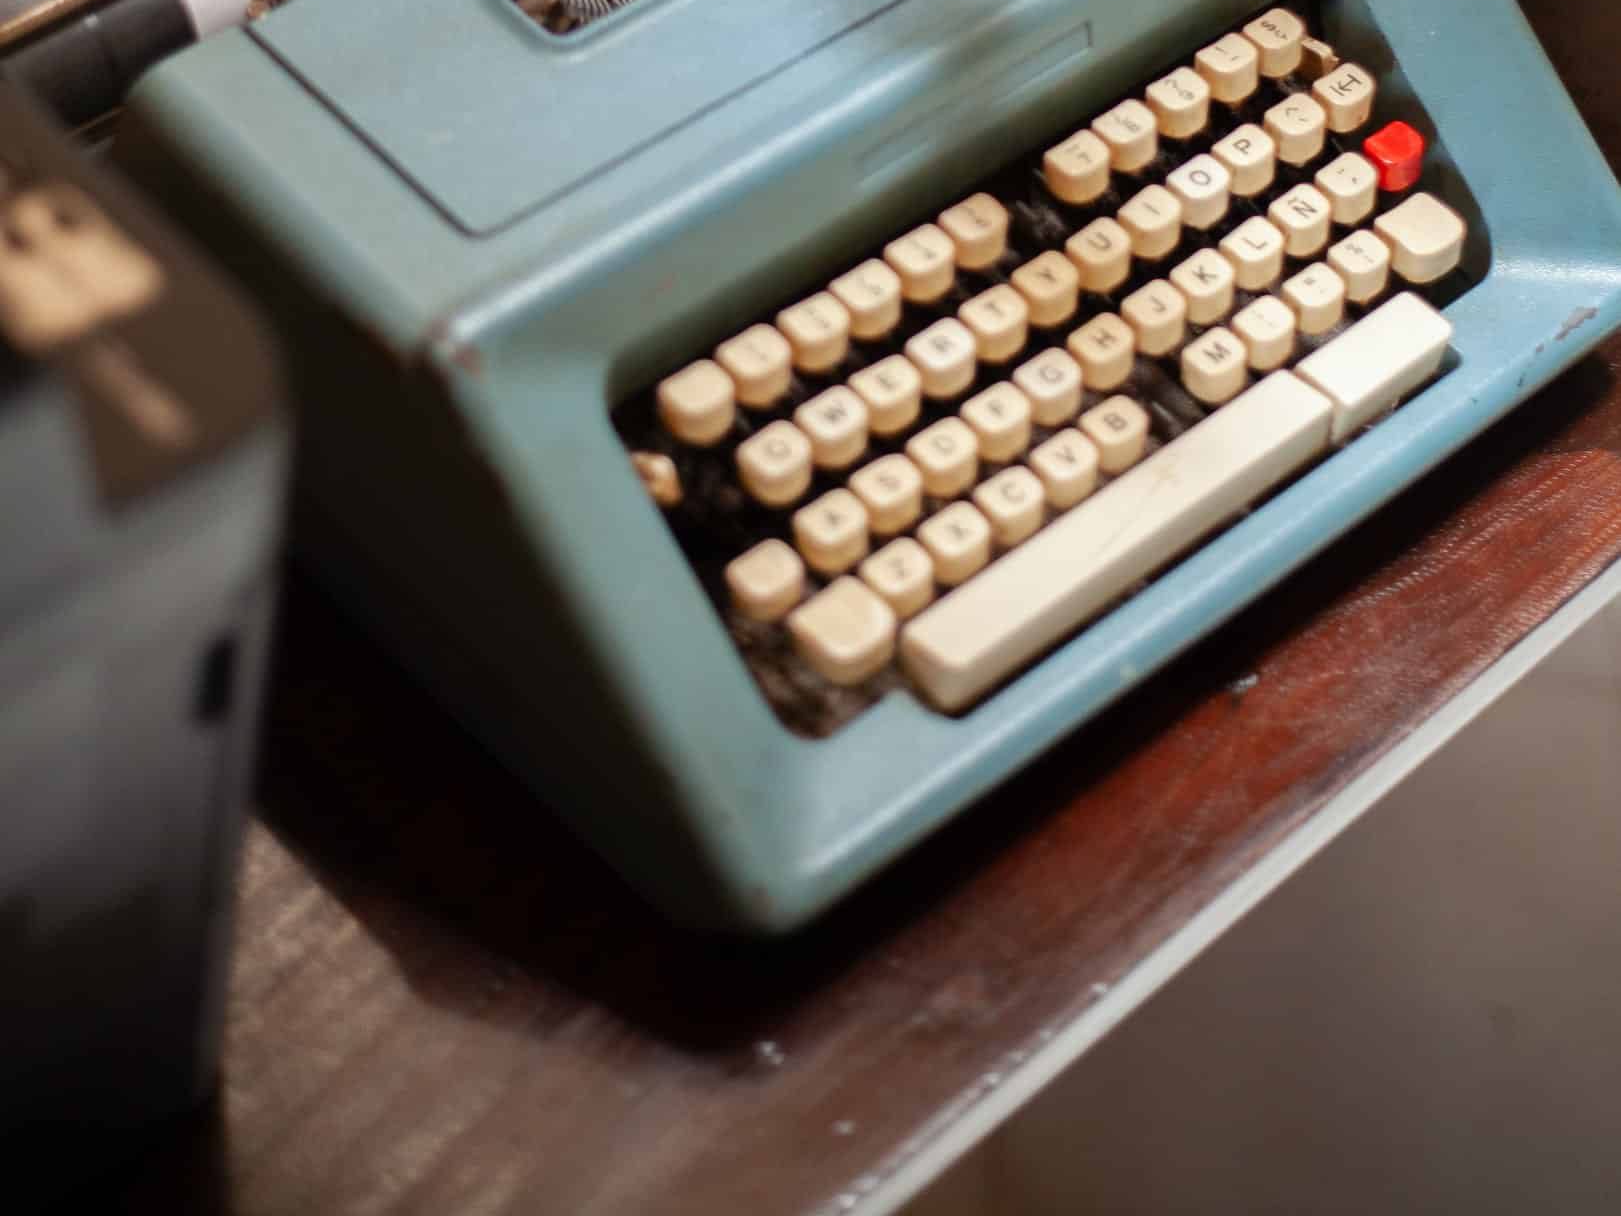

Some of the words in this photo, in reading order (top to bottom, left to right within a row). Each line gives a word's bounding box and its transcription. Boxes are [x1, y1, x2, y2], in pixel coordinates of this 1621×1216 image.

[1088, 232, 1113, 251] U
[1188, 170, 1211, 186] O
[1232, 138, 1251, 155] P
[1089, 326, 1116, 348] H
[1149, 295, 1167, 314] J
[1191, 265, 1218, 284] K
[1241, 236, 1269, 250] L
[1288, 196, 1317, 219] Ñ
[1102, 411, 1130, 432] B
[1202, 341, 1232, 364] M
